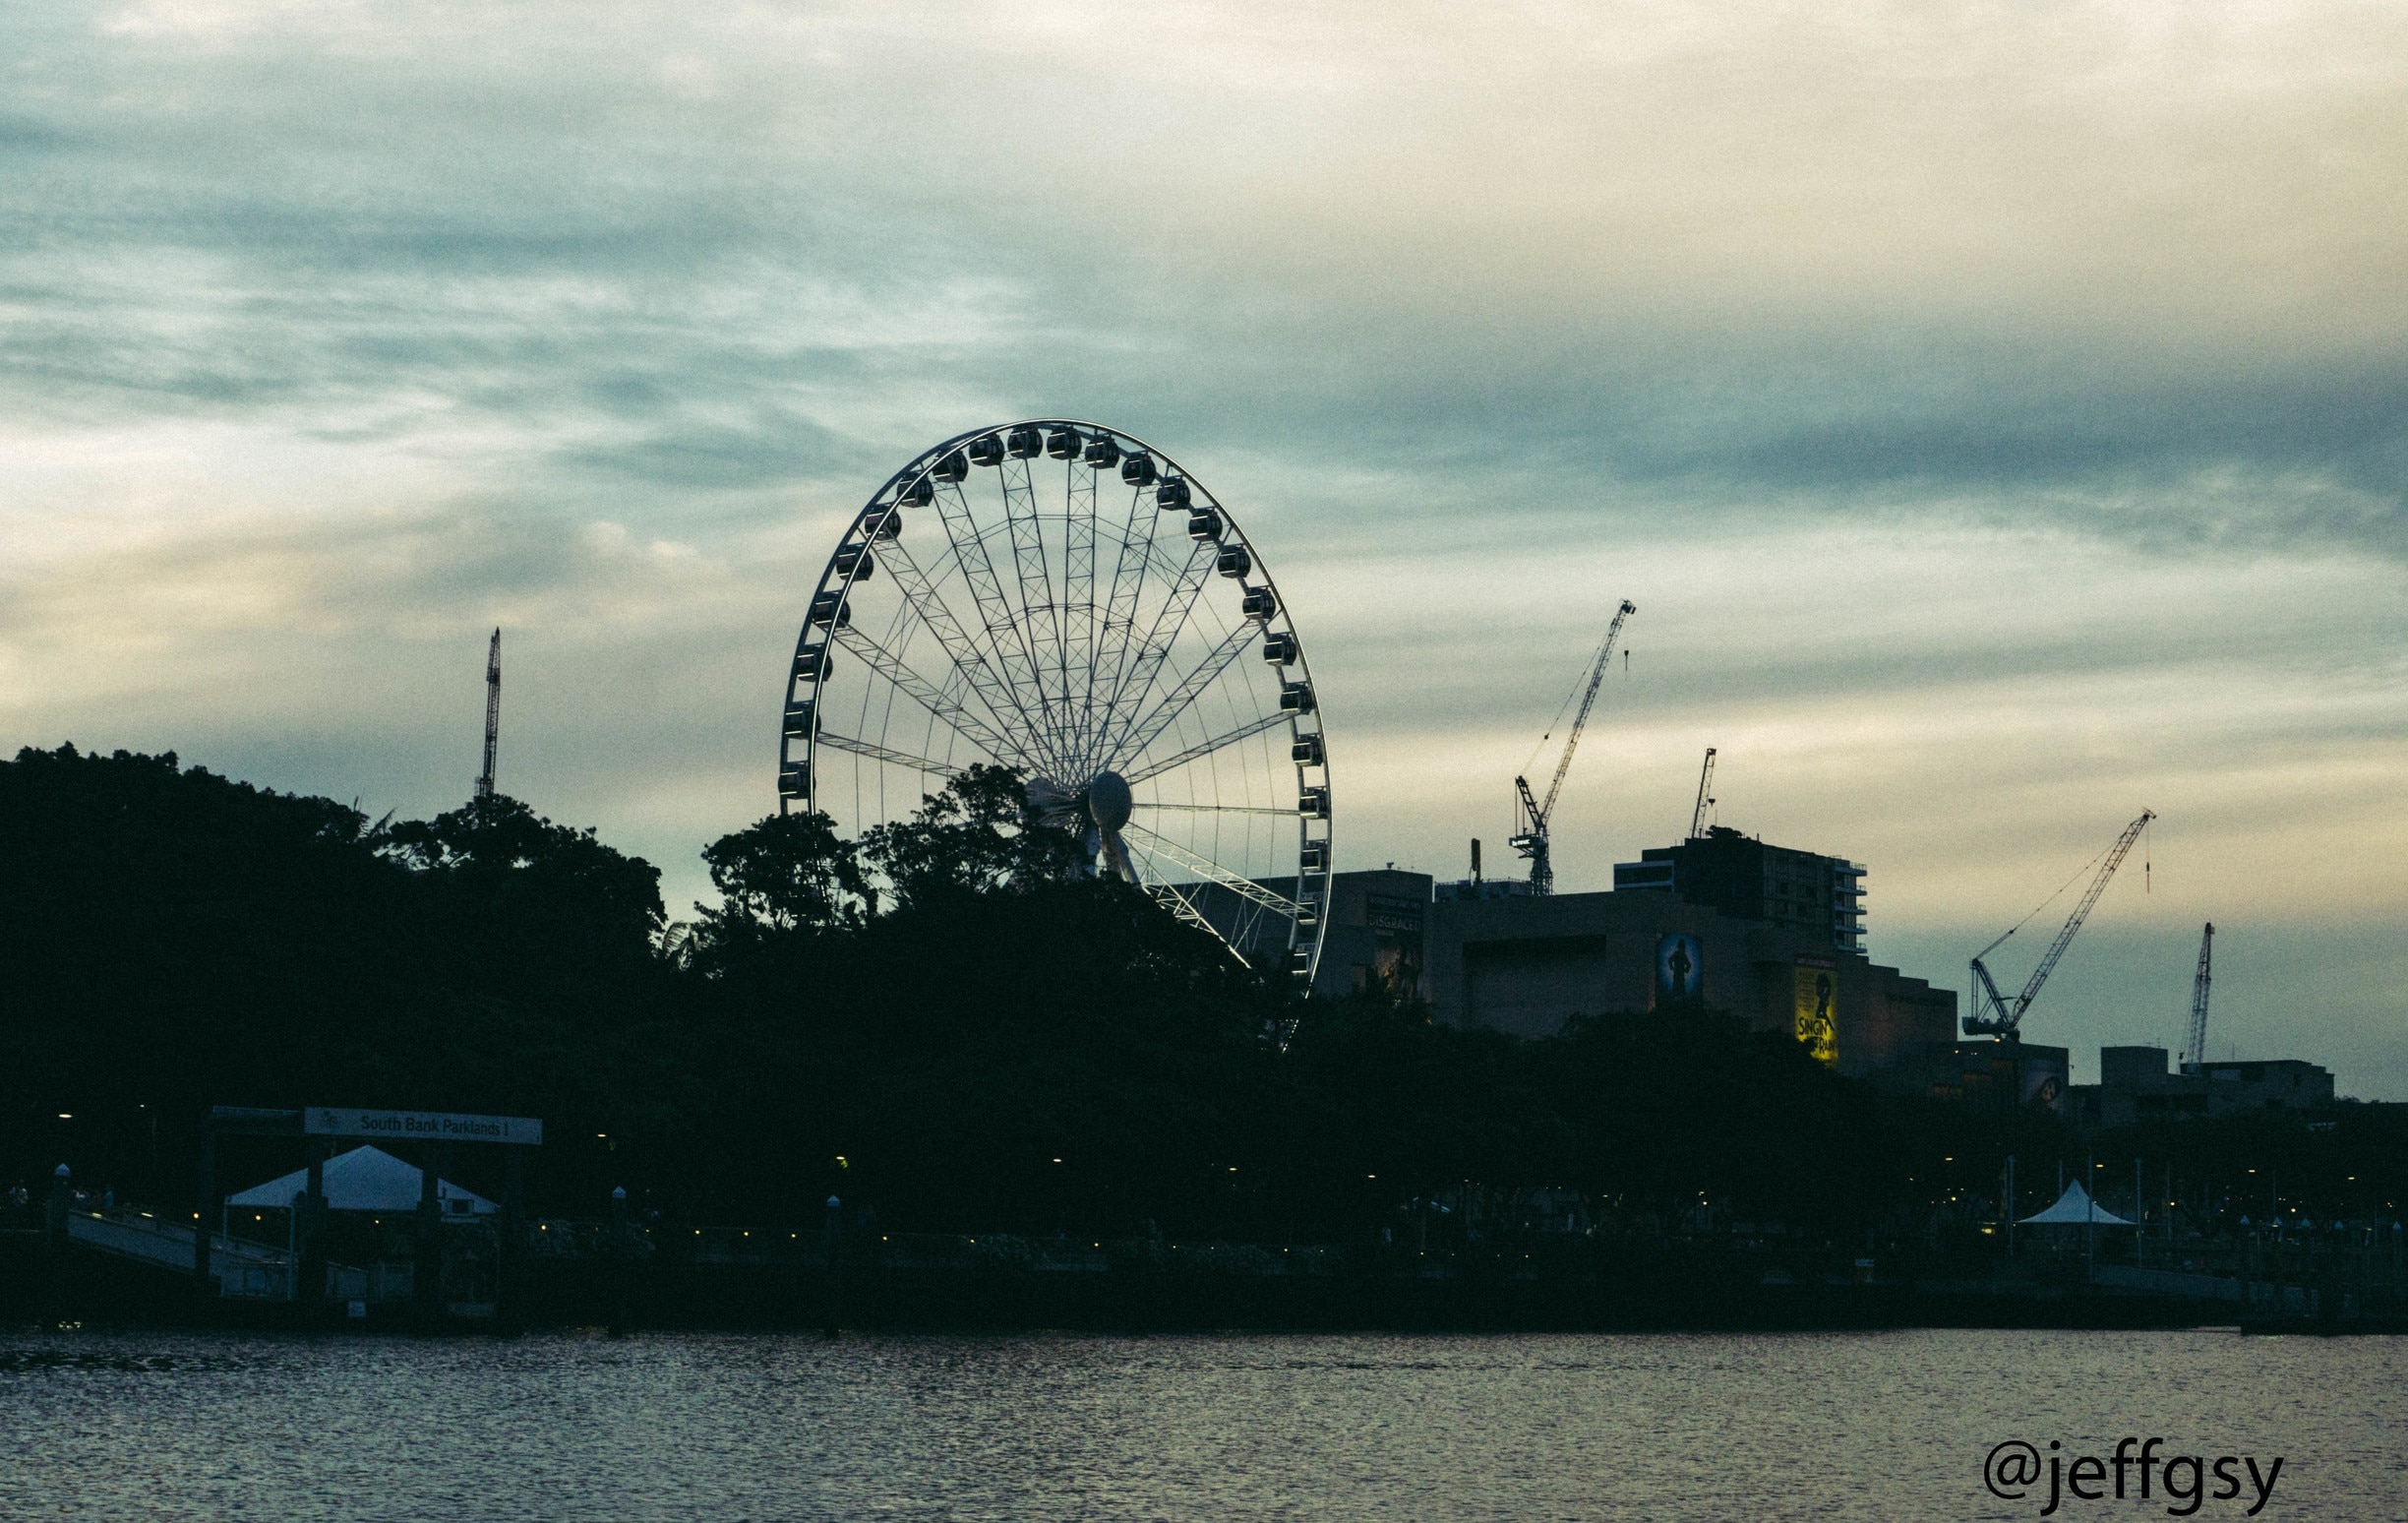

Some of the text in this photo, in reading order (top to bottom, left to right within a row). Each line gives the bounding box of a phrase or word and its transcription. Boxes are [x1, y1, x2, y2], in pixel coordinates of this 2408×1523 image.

[361, 1115, 400, 1131] South
[405, 1117, 439, 1132] Bank
[443, 1120, 501, 1136] Parklands
